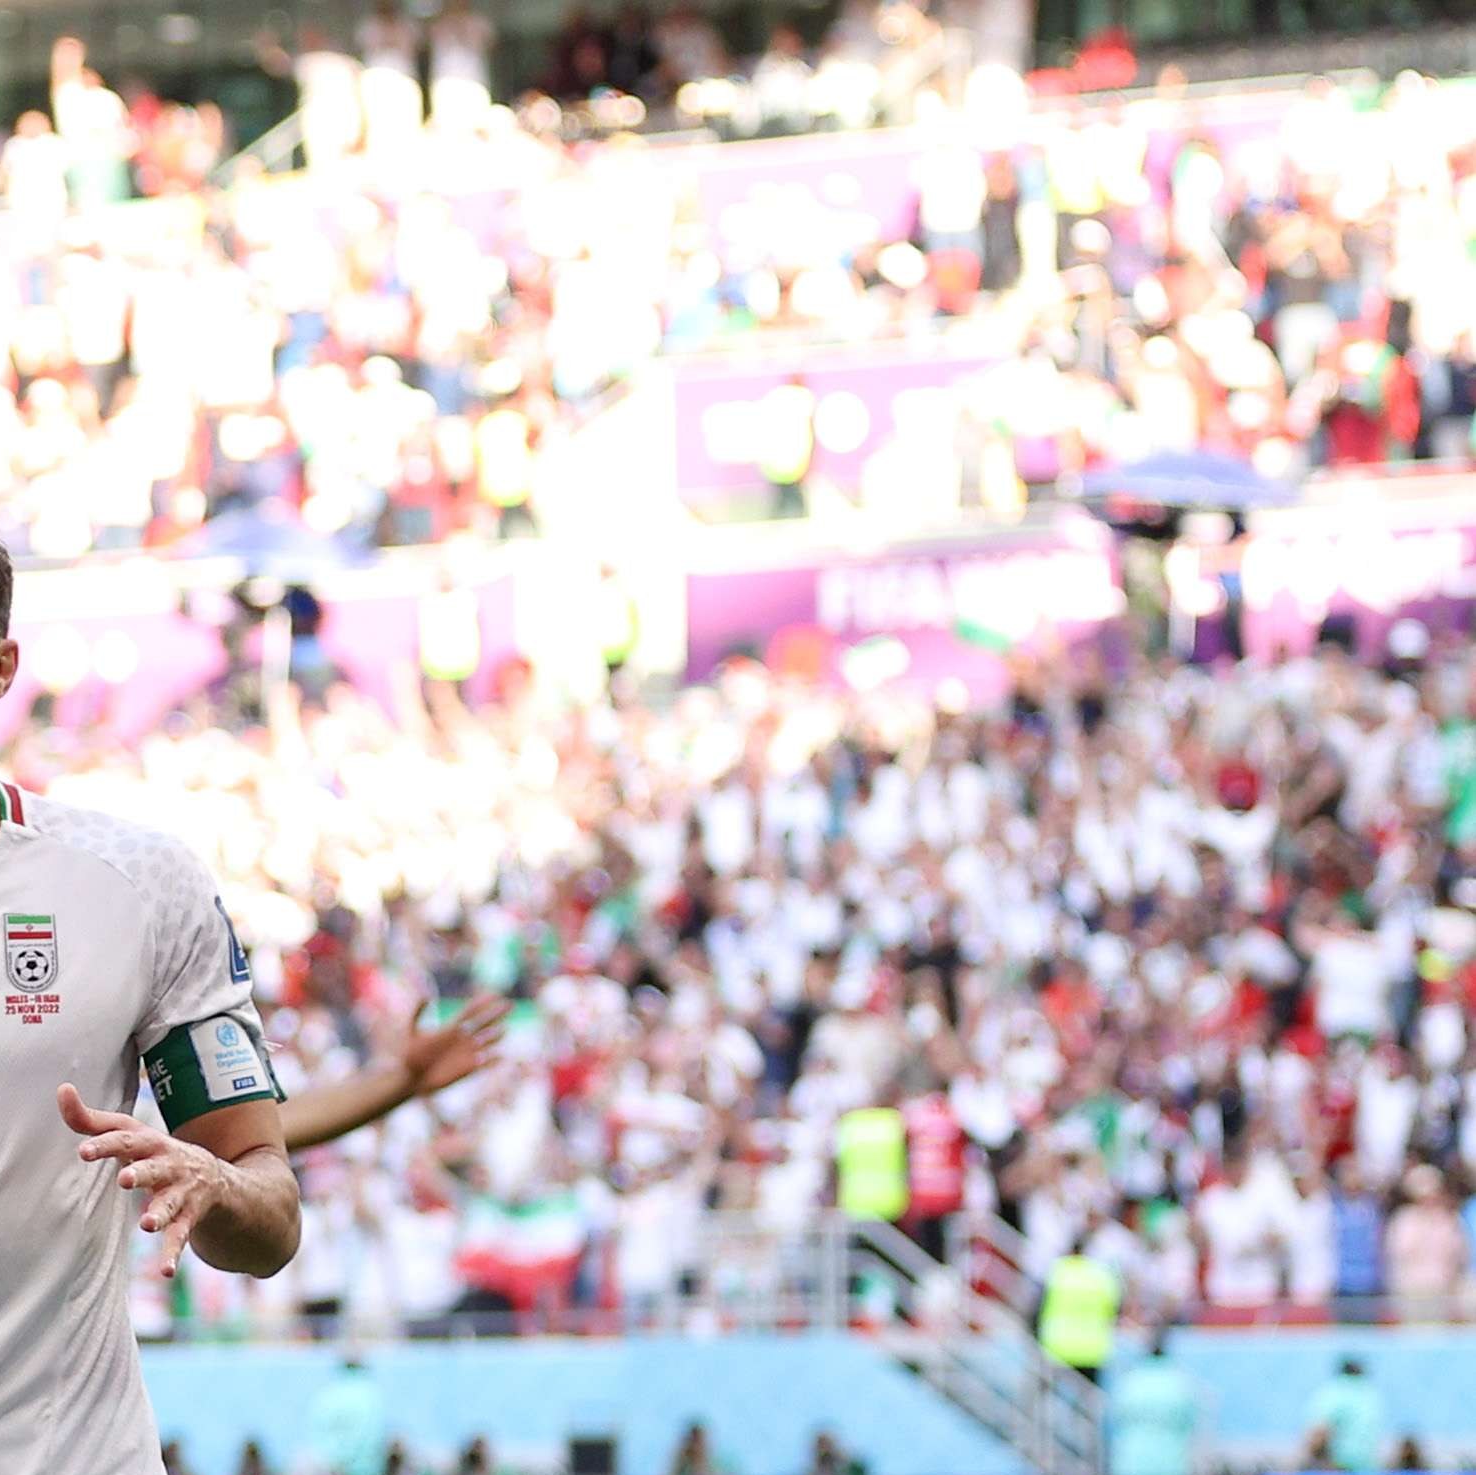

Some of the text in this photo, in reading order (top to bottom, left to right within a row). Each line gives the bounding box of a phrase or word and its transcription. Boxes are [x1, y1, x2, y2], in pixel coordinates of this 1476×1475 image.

[5, 1003, 59, 1015] 25 NOV 2022
